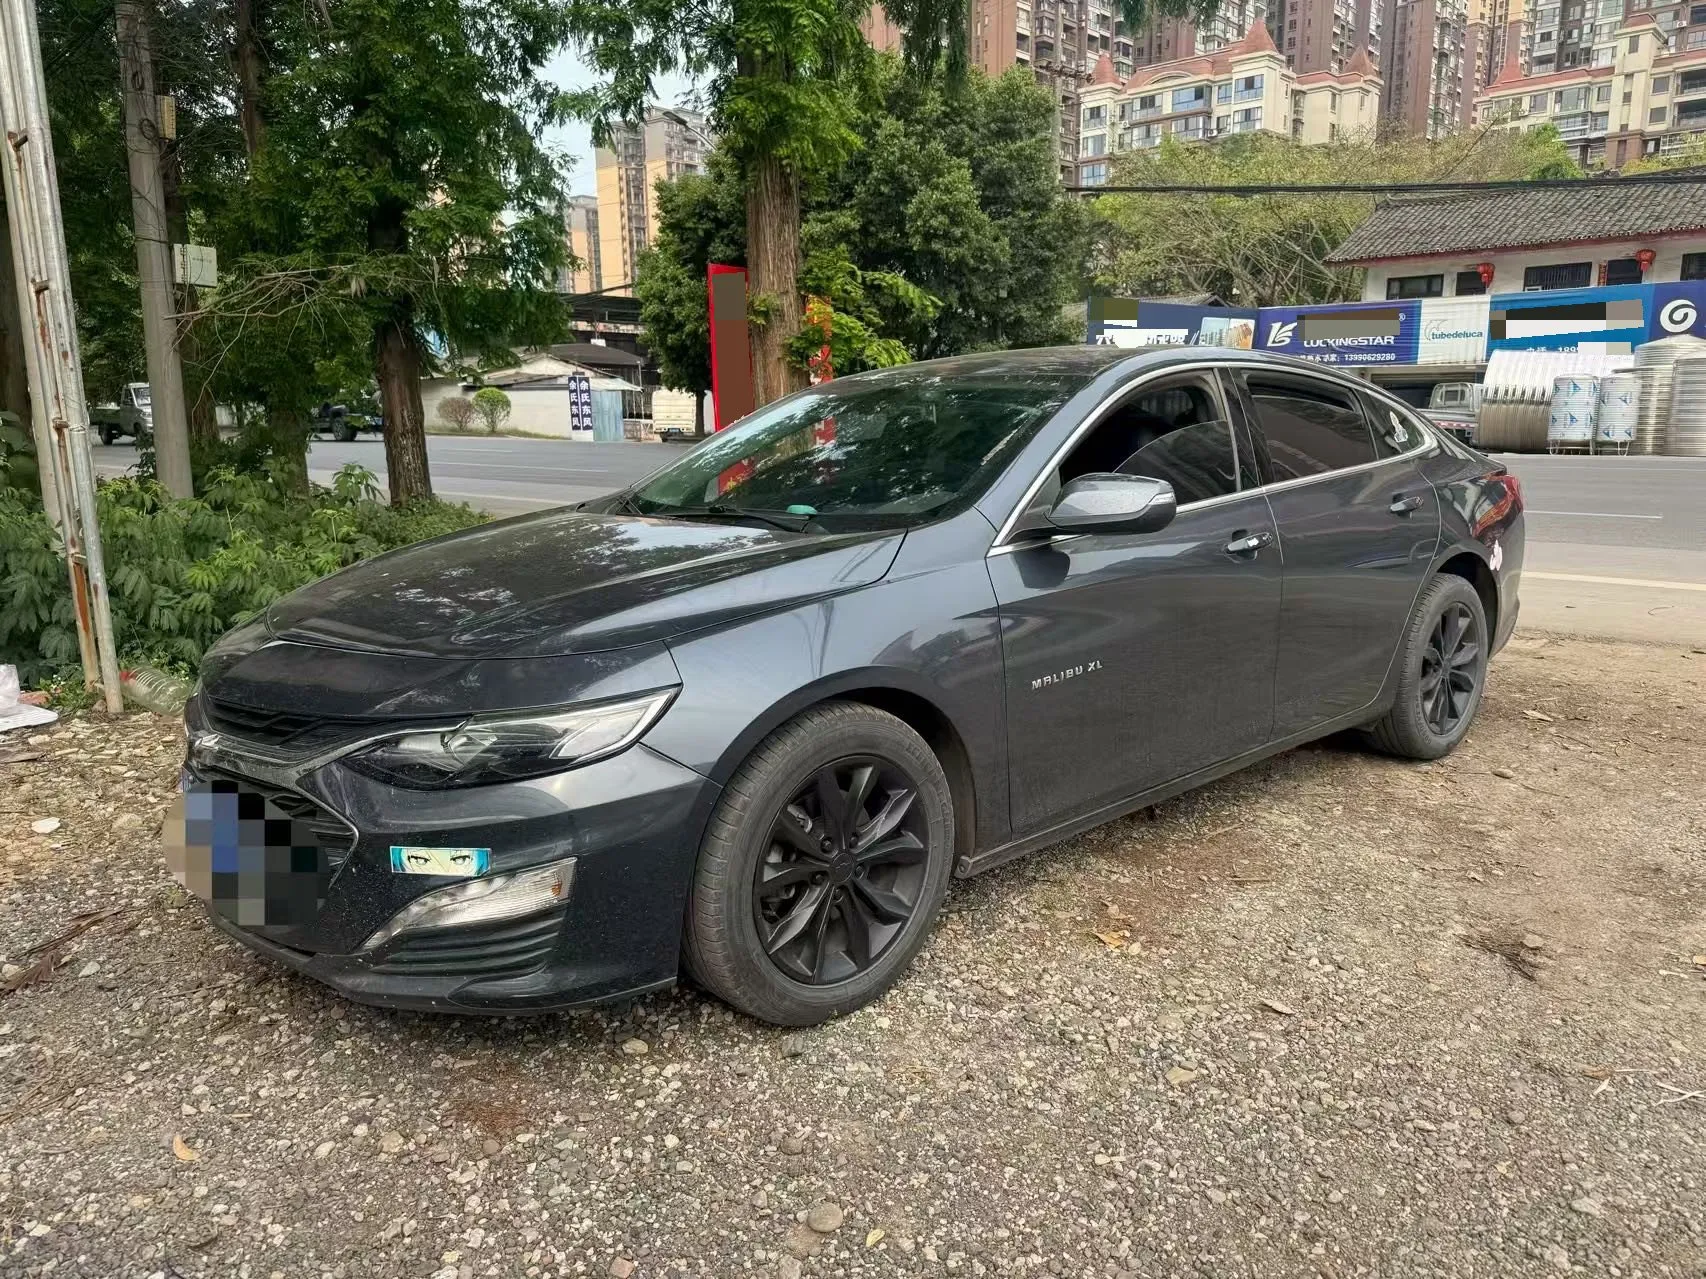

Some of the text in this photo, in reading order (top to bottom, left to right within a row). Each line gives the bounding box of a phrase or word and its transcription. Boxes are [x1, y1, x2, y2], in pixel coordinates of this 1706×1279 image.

[1431, 330, 1483, 340] tubedeluca
[1303, 336, 1395, 347] LUCKINGSTAR
[1344, 352, 1396, 361] 13990629280
[1031, 660, 1103, 690] MALIBU XL
